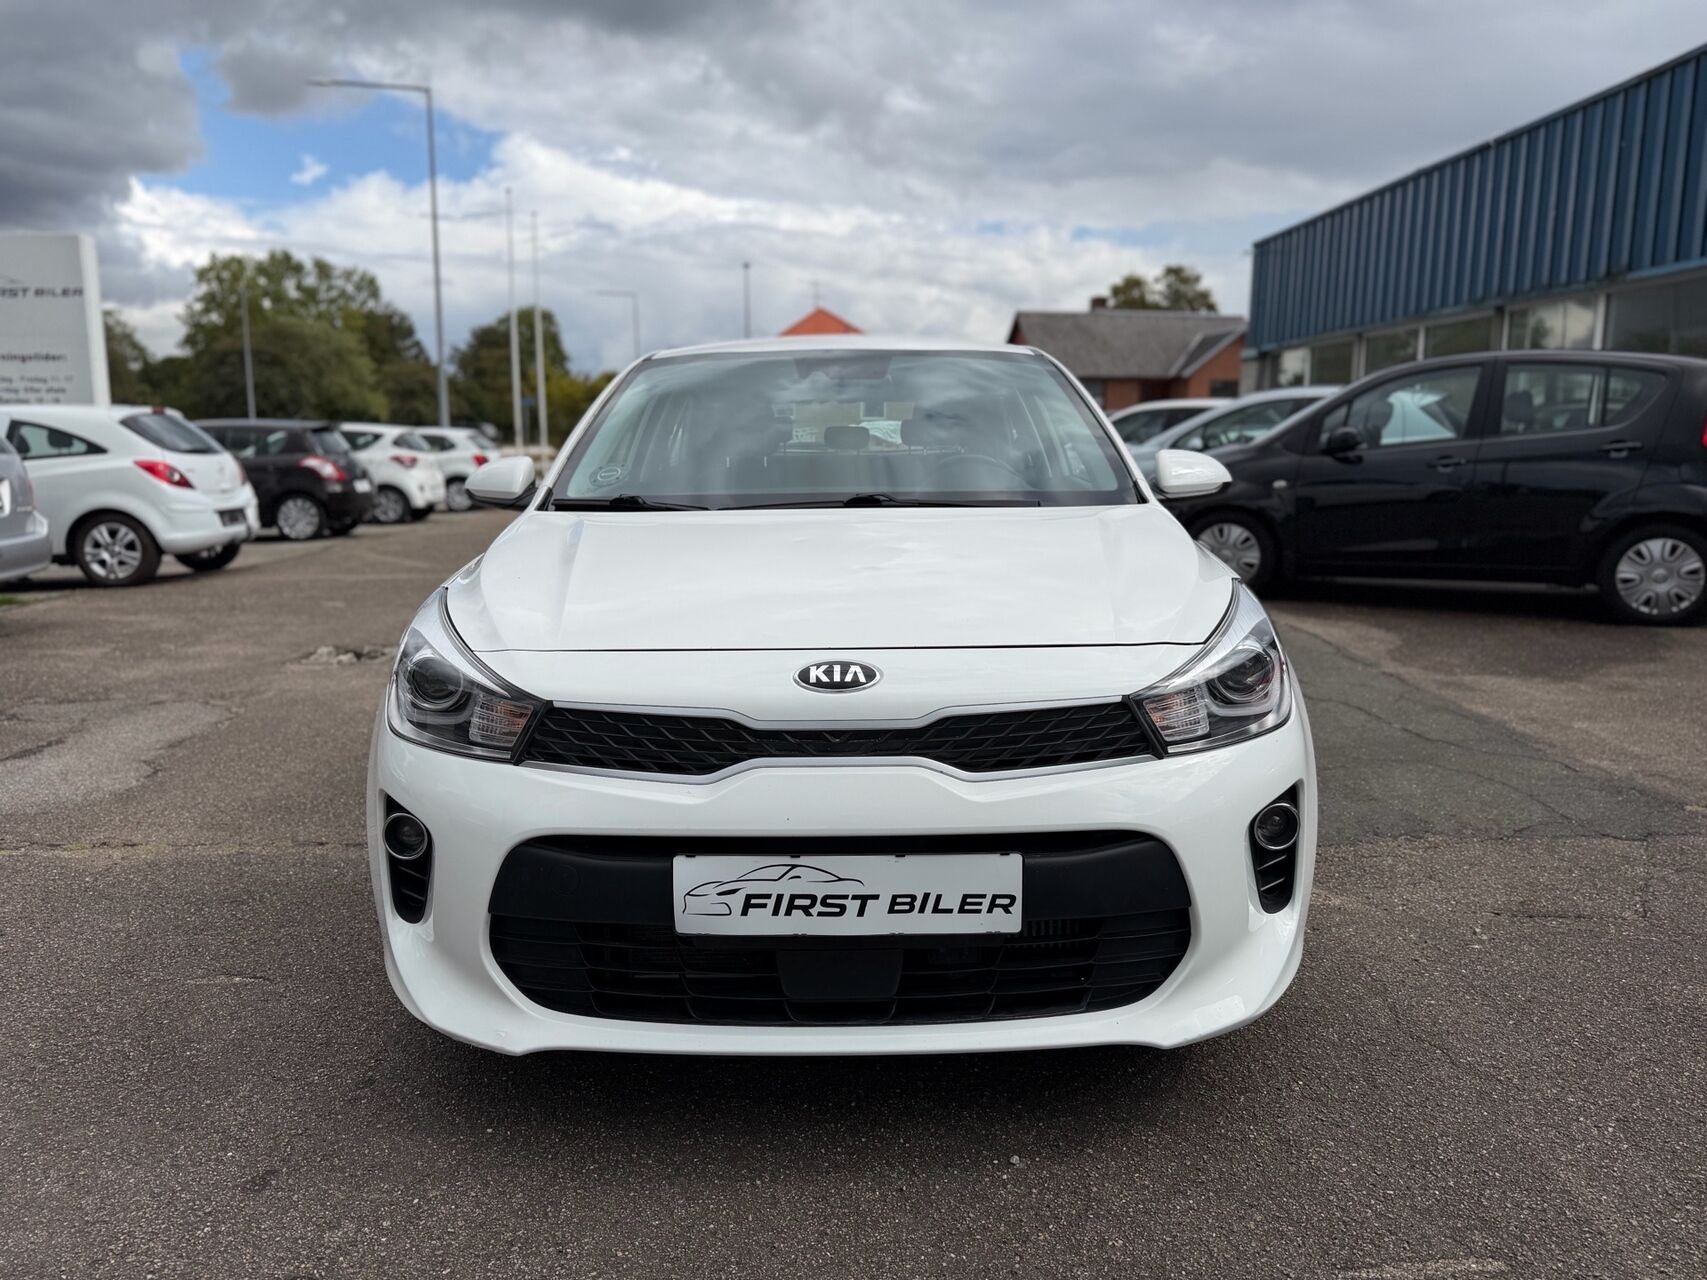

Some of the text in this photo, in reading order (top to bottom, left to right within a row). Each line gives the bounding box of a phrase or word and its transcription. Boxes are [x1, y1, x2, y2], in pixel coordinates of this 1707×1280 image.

[809, 665, 866, 683] KIA
[740, 892, 1017, 918] FIRST BILER
